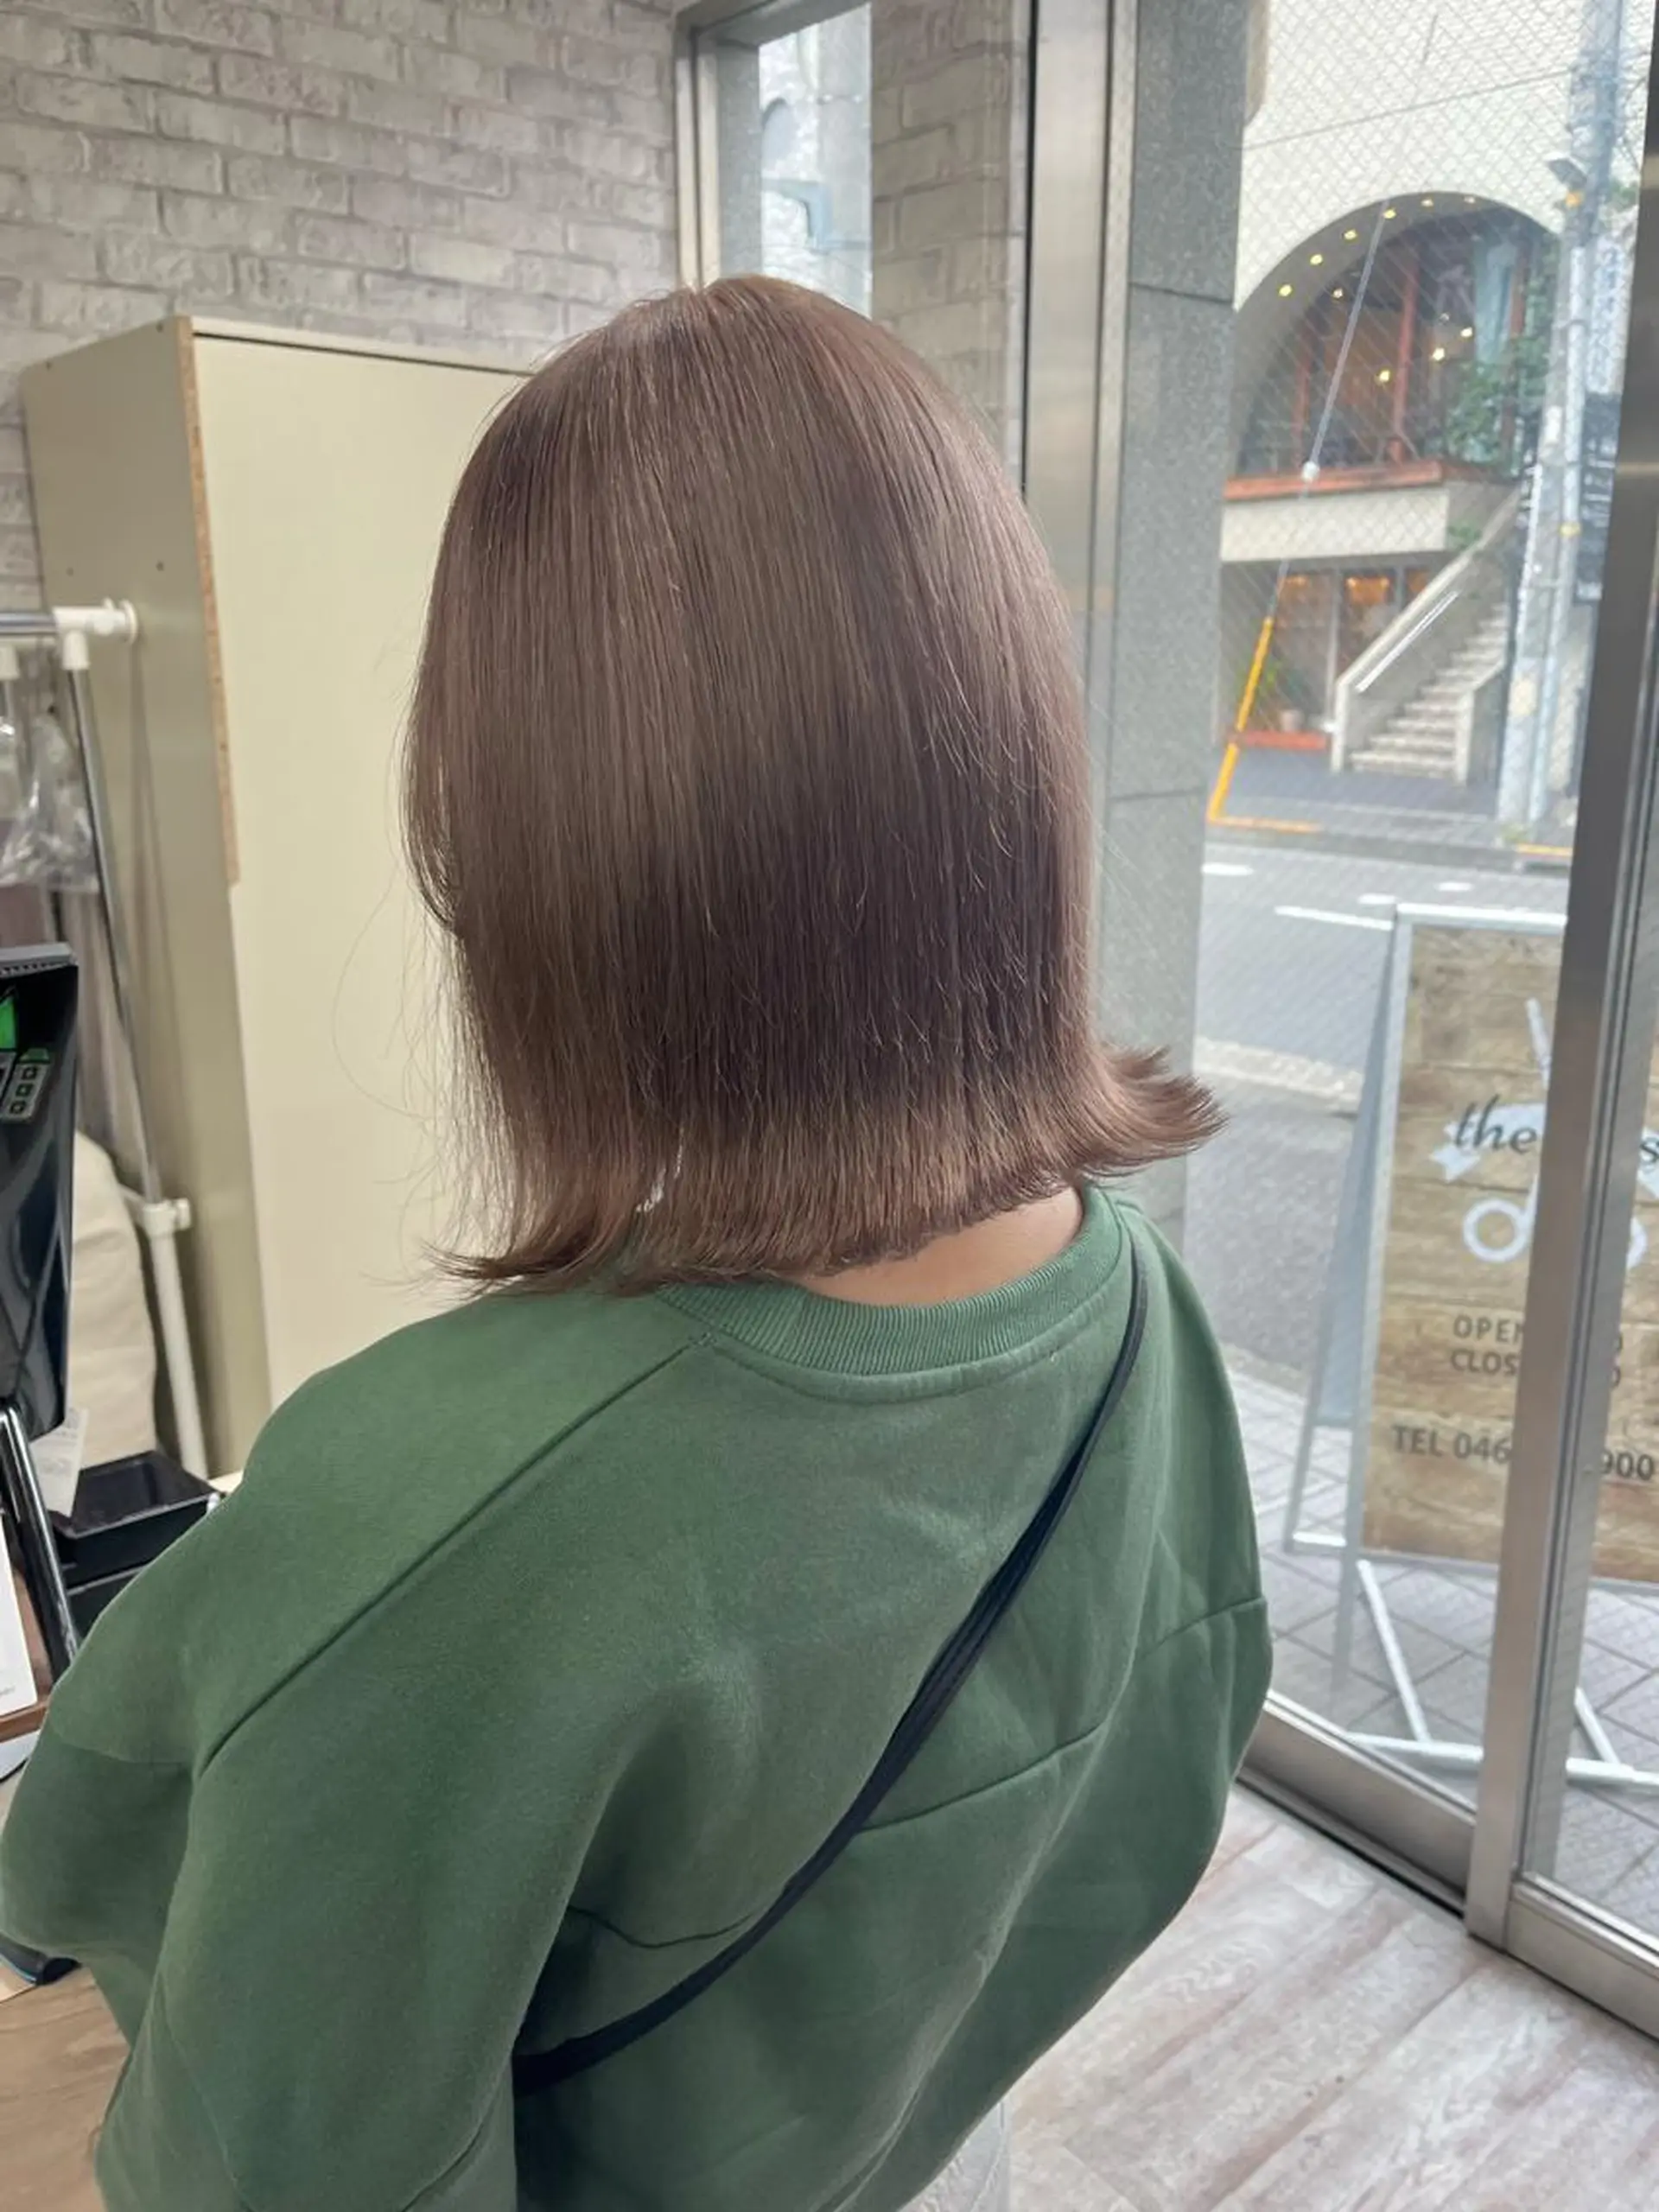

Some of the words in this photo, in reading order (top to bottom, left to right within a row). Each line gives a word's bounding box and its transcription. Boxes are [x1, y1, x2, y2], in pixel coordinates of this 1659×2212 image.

[1455, 1094, 1538, 1154] the
[1450, 1348, 1520, 1377] CLOS
[1391, 1424, 1444, 1458] TEL
